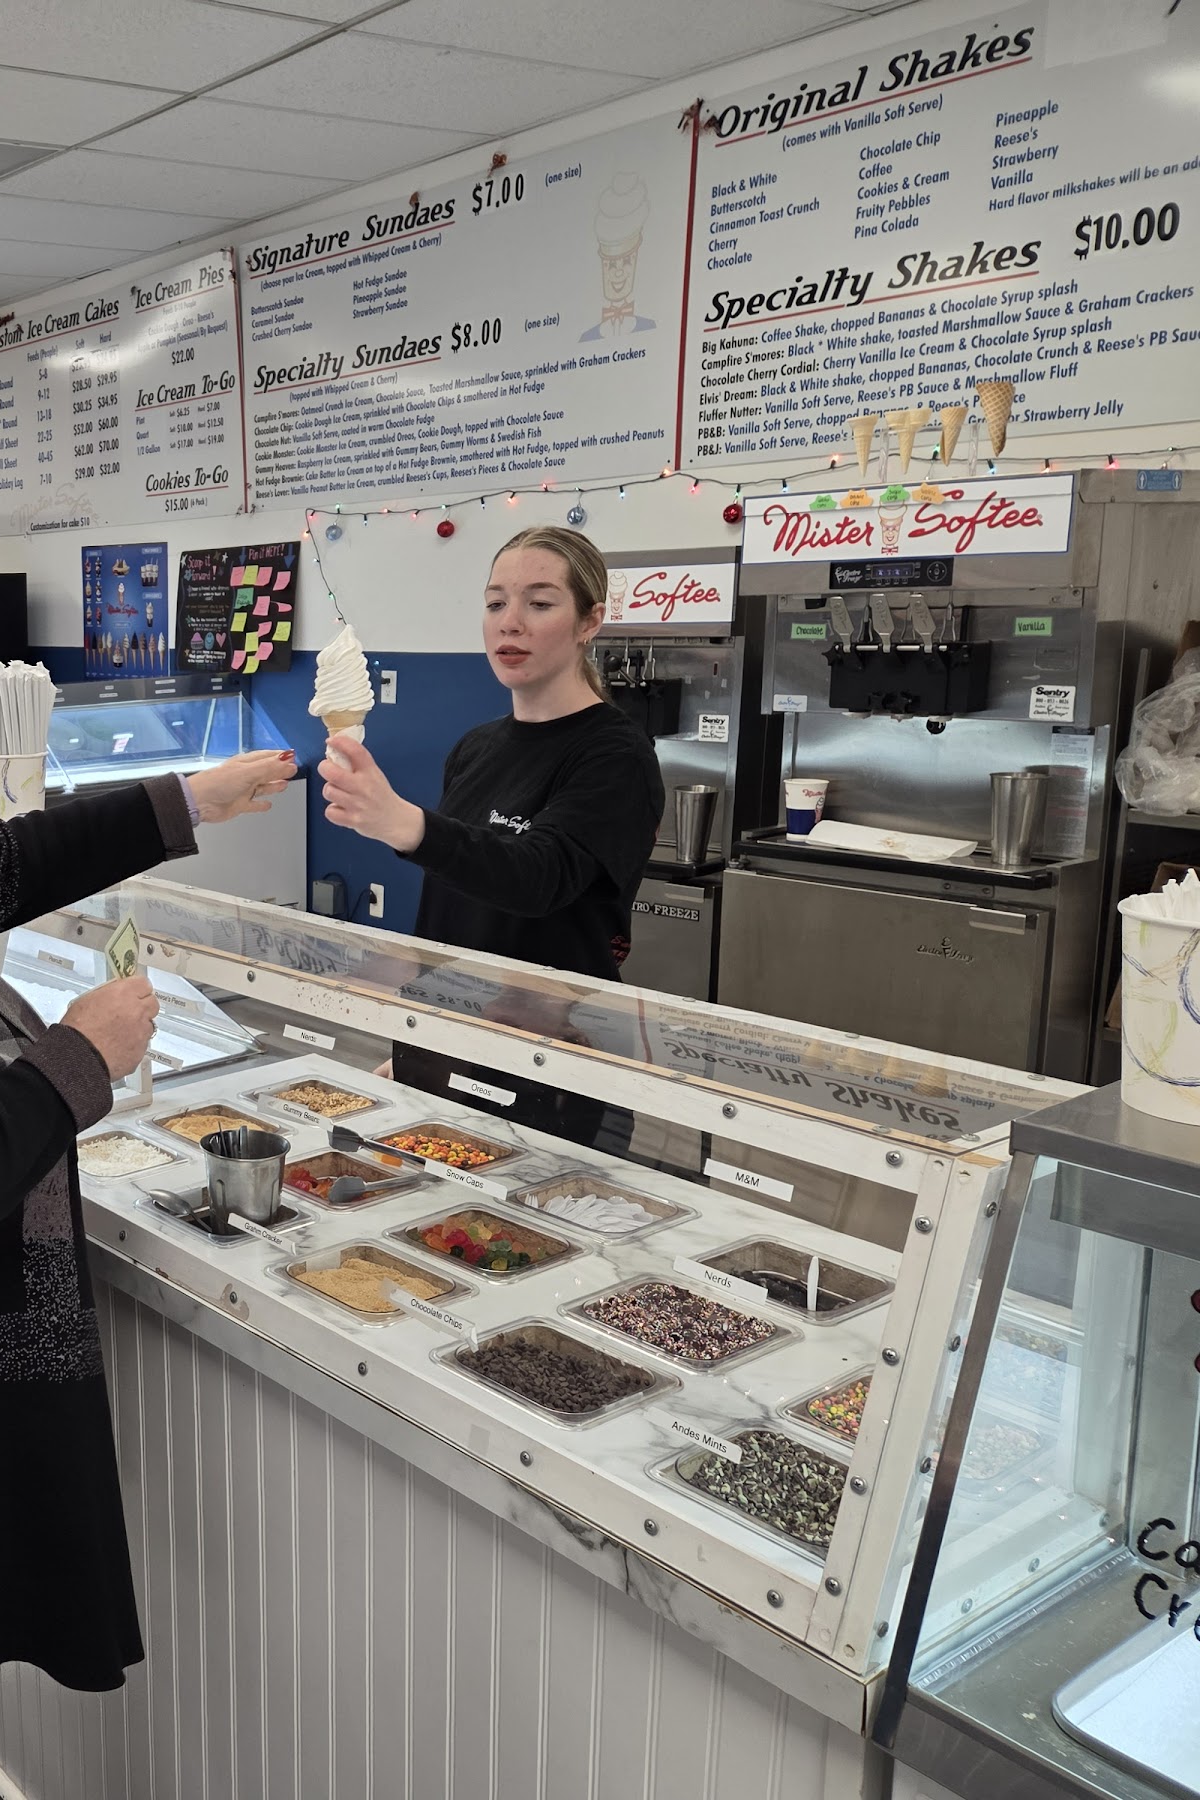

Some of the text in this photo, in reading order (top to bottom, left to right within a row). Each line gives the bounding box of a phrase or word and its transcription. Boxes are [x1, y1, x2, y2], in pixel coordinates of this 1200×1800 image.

[716, 27, 1035, 138] Original Shakes
[782, 94, 942, 151] (comes with Vanilla Soft Serve)
[996, 100, 1059, 127] Pineapple
[860, 131, 941, 161] Chocolate Chip
[995, 126, 1038, 149] Reese's
[992, 145, 1059, 169] Strawberry
[859, 162, 892, 180] Coffee
[991, 169, 1033, 190] Vanilla
[712, 173, 777, 198] Black & White
[857, 170, 949, 200] Cookies & Cream
[989, 165, 1178, 211] Hard flavor milkshakes will be an
[710, 192, 766, 216] Butterscotch
[710, 197, 820, 234] Cinnamon Toast Crunch
[856, 193, 930, 220] Fruity Pebbles
[250, 163, 582, 275] Signature Sundaes $7.00 (one size)
[854, 215, 919, 239] Pina Colada
[1074, 202, 1180, 260] $10.00
[709, 237, 738, 252] Cherry
[708, 252, 752, 270] Chocolate
[135, 265, 224, 309] Ice Cream Pies
[704, 239, 1042, 329] Specialty Shakes
[27, 320, 42, 340] Ice
[45, 314, 80, 333] Cream
[85, 299, 119, 322] Cakes
[353, 298, 408, 319] Strawberry Sundae
[702, 279, 1078, 354] Big Kahuna: Coffee Shake, chopped Bananas & Chocolate Syrup splash
[171, 348, 195, 365] $22.00
[254, 313, 560, 393] Specialty Sundaes $8.00 (one size)
[579, 348, 646, 367] Graham Crackers
[701, 316, 1112, 388] Chocolate Cherry Cordial: Cherry Vanilla Ice Cream & Chocolate Syrup splash
[136, 370, 235, 408] Ice Cream To-Go
[74, 416, 118, 436] $52.00 $60.00
[600, 429, 664, 445] crushed Peanuts
[74, 438, 119, 457] $62.00 $70.00
[75, 462, 120, 480] $29.00 $32.00
[146, 465, 229, 492] Cookies To-Go
[165, 498, 188, 512] $15.00
[763, 490, 1043, 556] Mister Softee
[629, 572, 720, 621] Softee
[796, 626, 823, 635] Chocolate
[1018, 622, 1045, 631] Vanilla
[1036, 686, 1070, 698] Sentry
[702, 716, 725, 725] Sentry
[508, 816, 531, 834] Soft
[654, 904, 698, 920] FREEZE
[301, 1032, 317, 1043] Nerds
[471, 1084, 491, 1096] Oreos
[283, 1104, 320, 1124] Gummy Bears
[446, 1168, 484, 1189] Snow Caps
[735, 1172, 759, 1187] M&M
[262, 1228, 283, 1245] Cracker
[705, 1270, 731, 1288] Nerds
[410, 1299, 463, 1330] Chocolate Chips
[672, 1422, 727, 1453] Andes Mints
